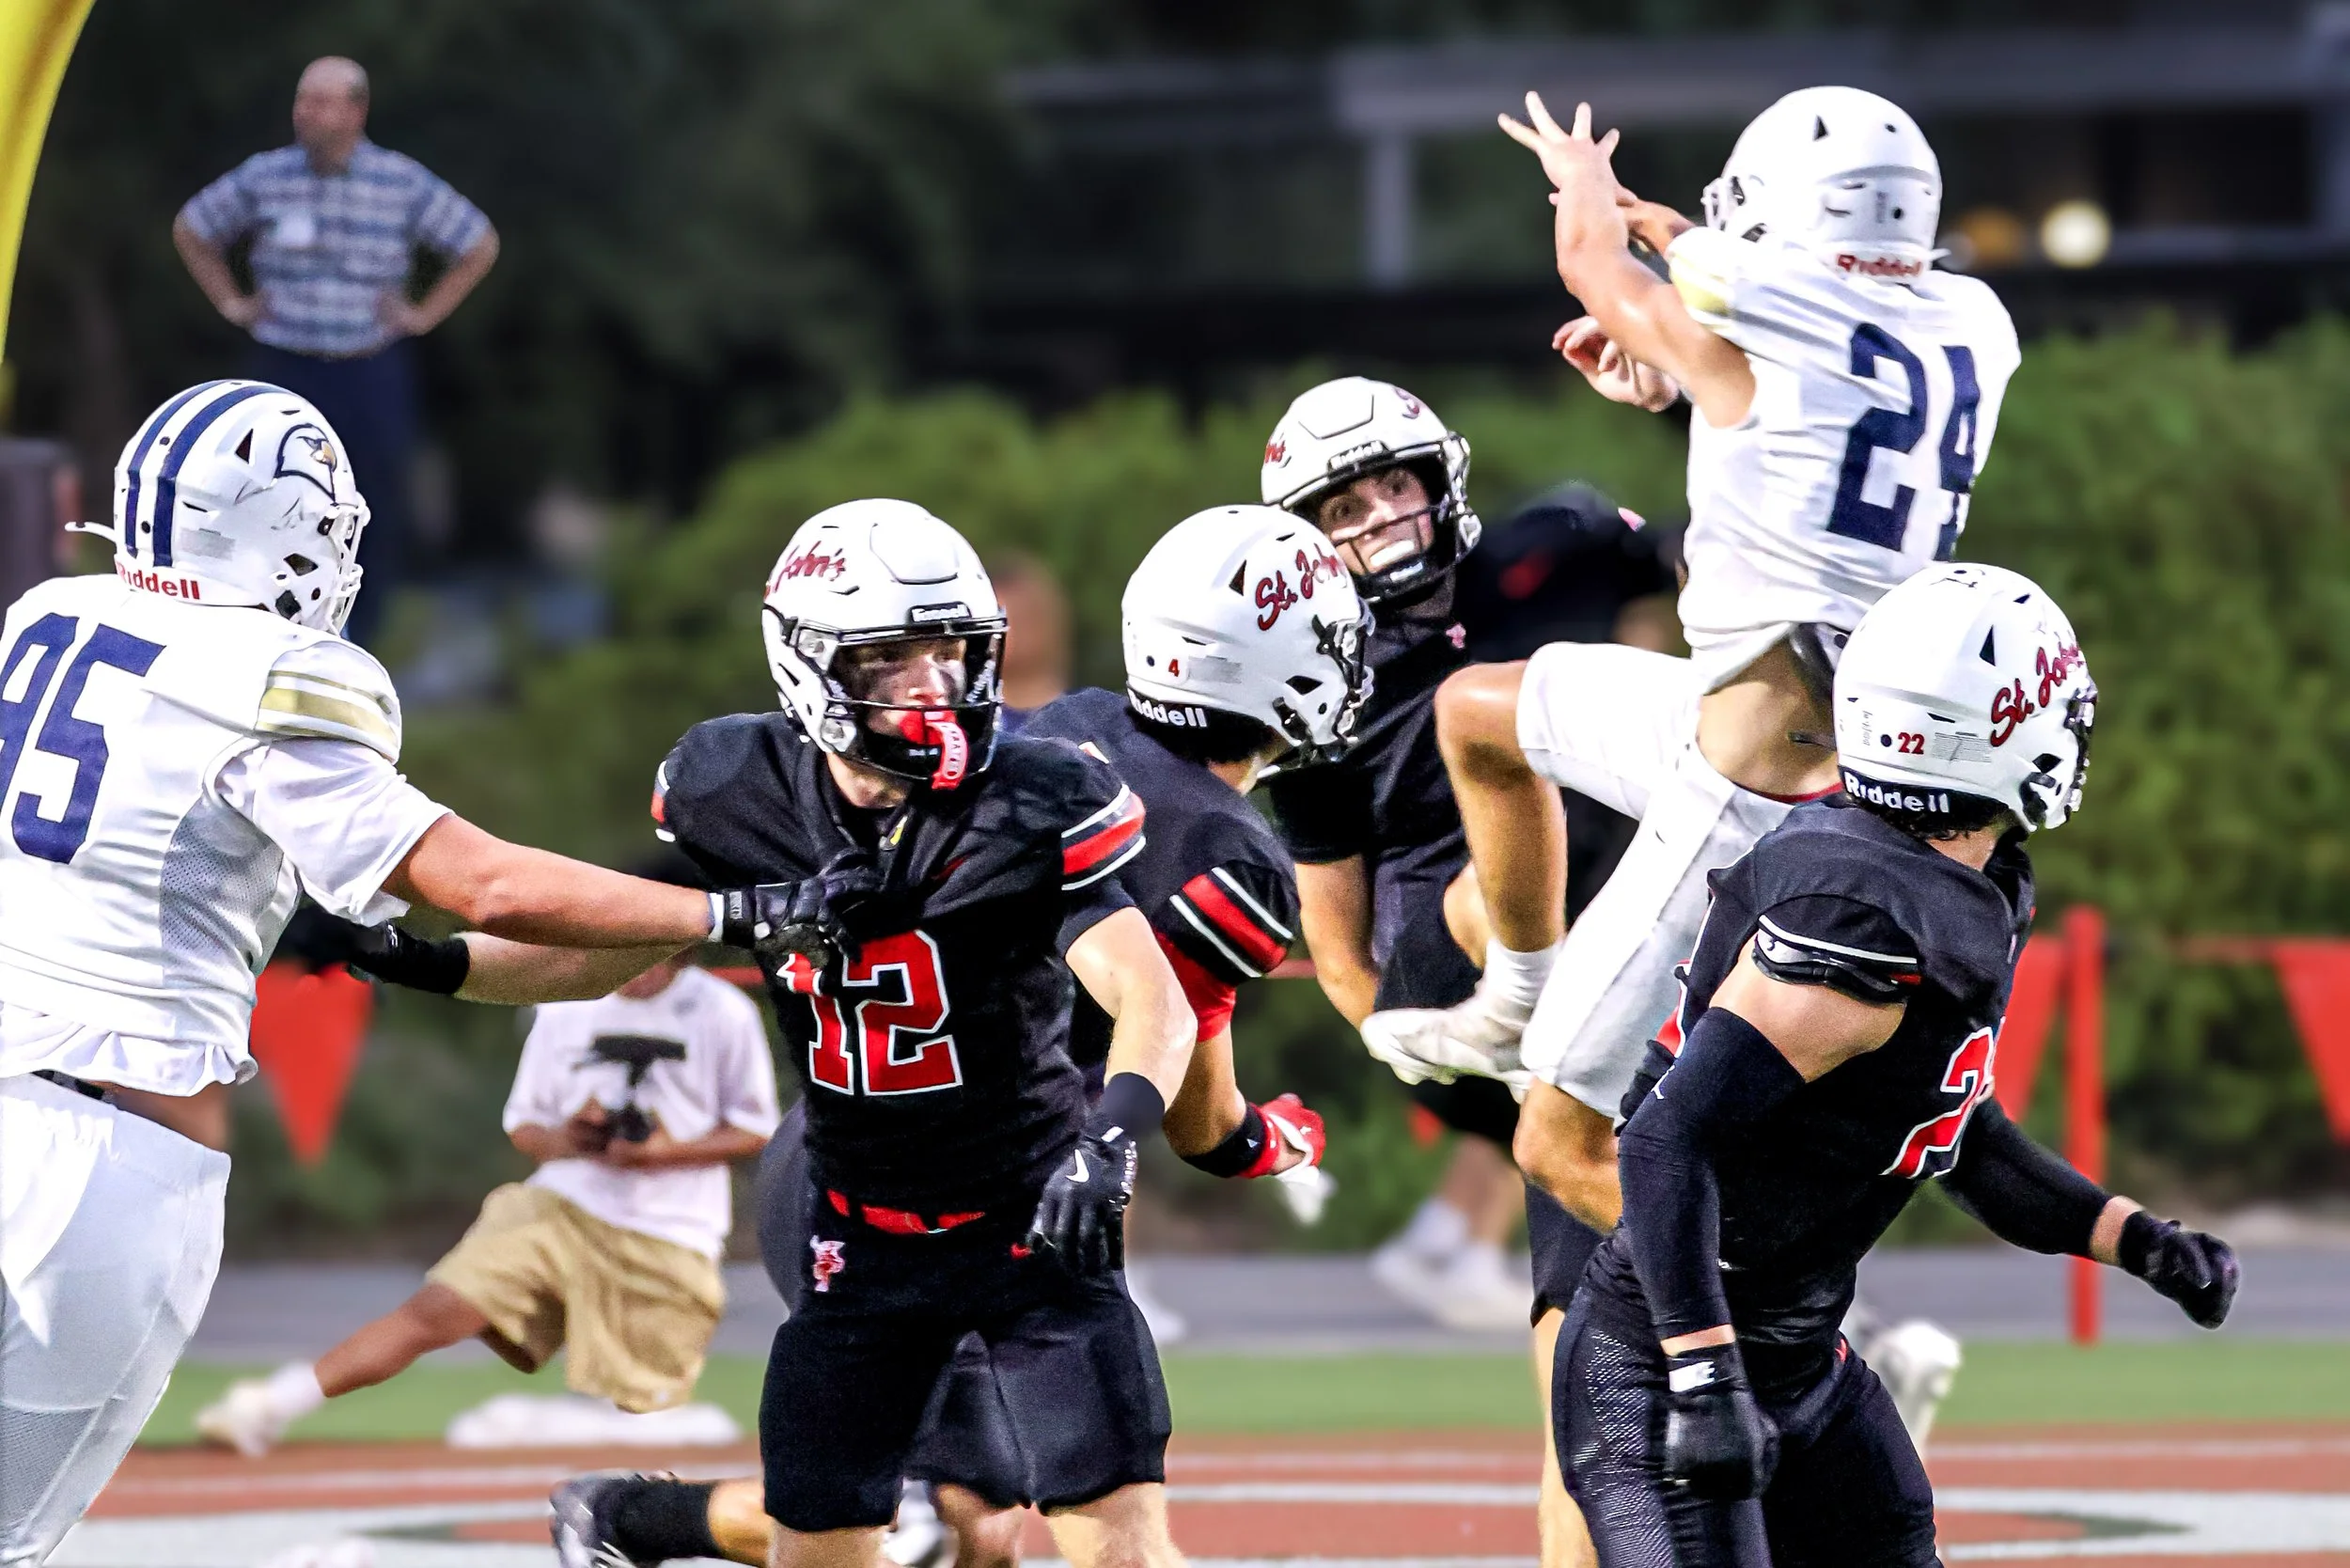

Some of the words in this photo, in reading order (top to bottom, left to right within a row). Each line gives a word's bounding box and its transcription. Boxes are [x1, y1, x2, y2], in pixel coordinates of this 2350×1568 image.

[1825, 322, 1980, 562] 24
[1167, 658, 1181, 678] 4
[0, 612, 167, 865] 95
[1897, 731, 1926, 756] 22
[1843, 770, 1950, 814] Riddell
[776, 928, 964, 1097] 12
